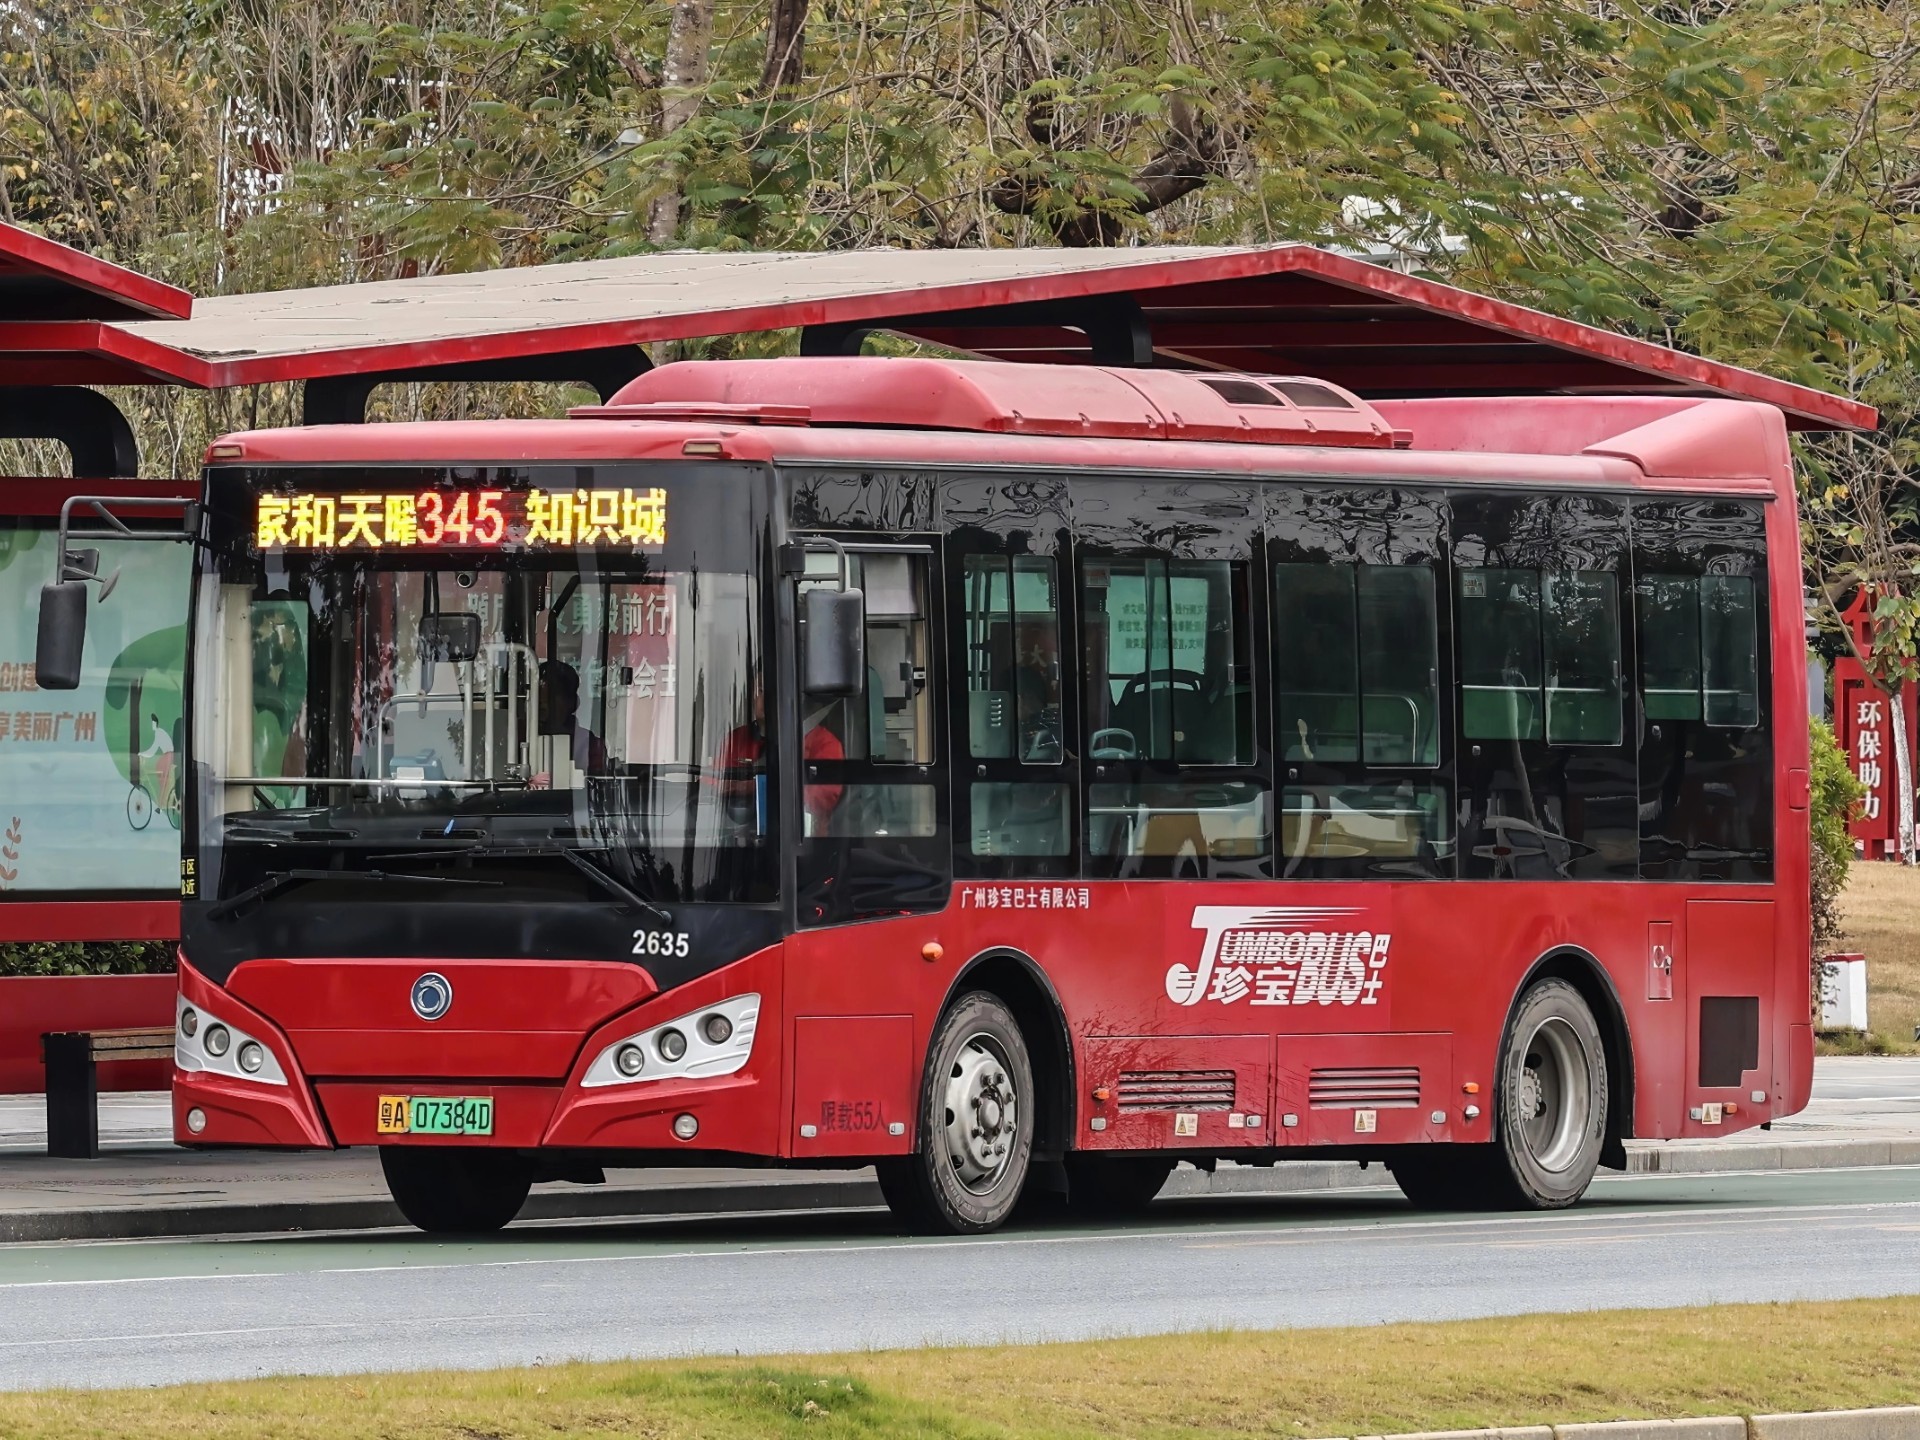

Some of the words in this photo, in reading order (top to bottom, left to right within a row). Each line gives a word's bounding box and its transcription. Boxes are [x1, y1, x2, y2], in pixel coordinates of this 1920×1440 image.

[417, 491, 503, 545] 345
[525, 488, 668, 546] 知识城
[1857, 700, 1882, 819] 环保助力
[961, 886, 1089, 909] 广州珍宝巴士有限公司
[632, 929, 689, 958] 2635
[821, 1100, 887, 1132] 限载55人
